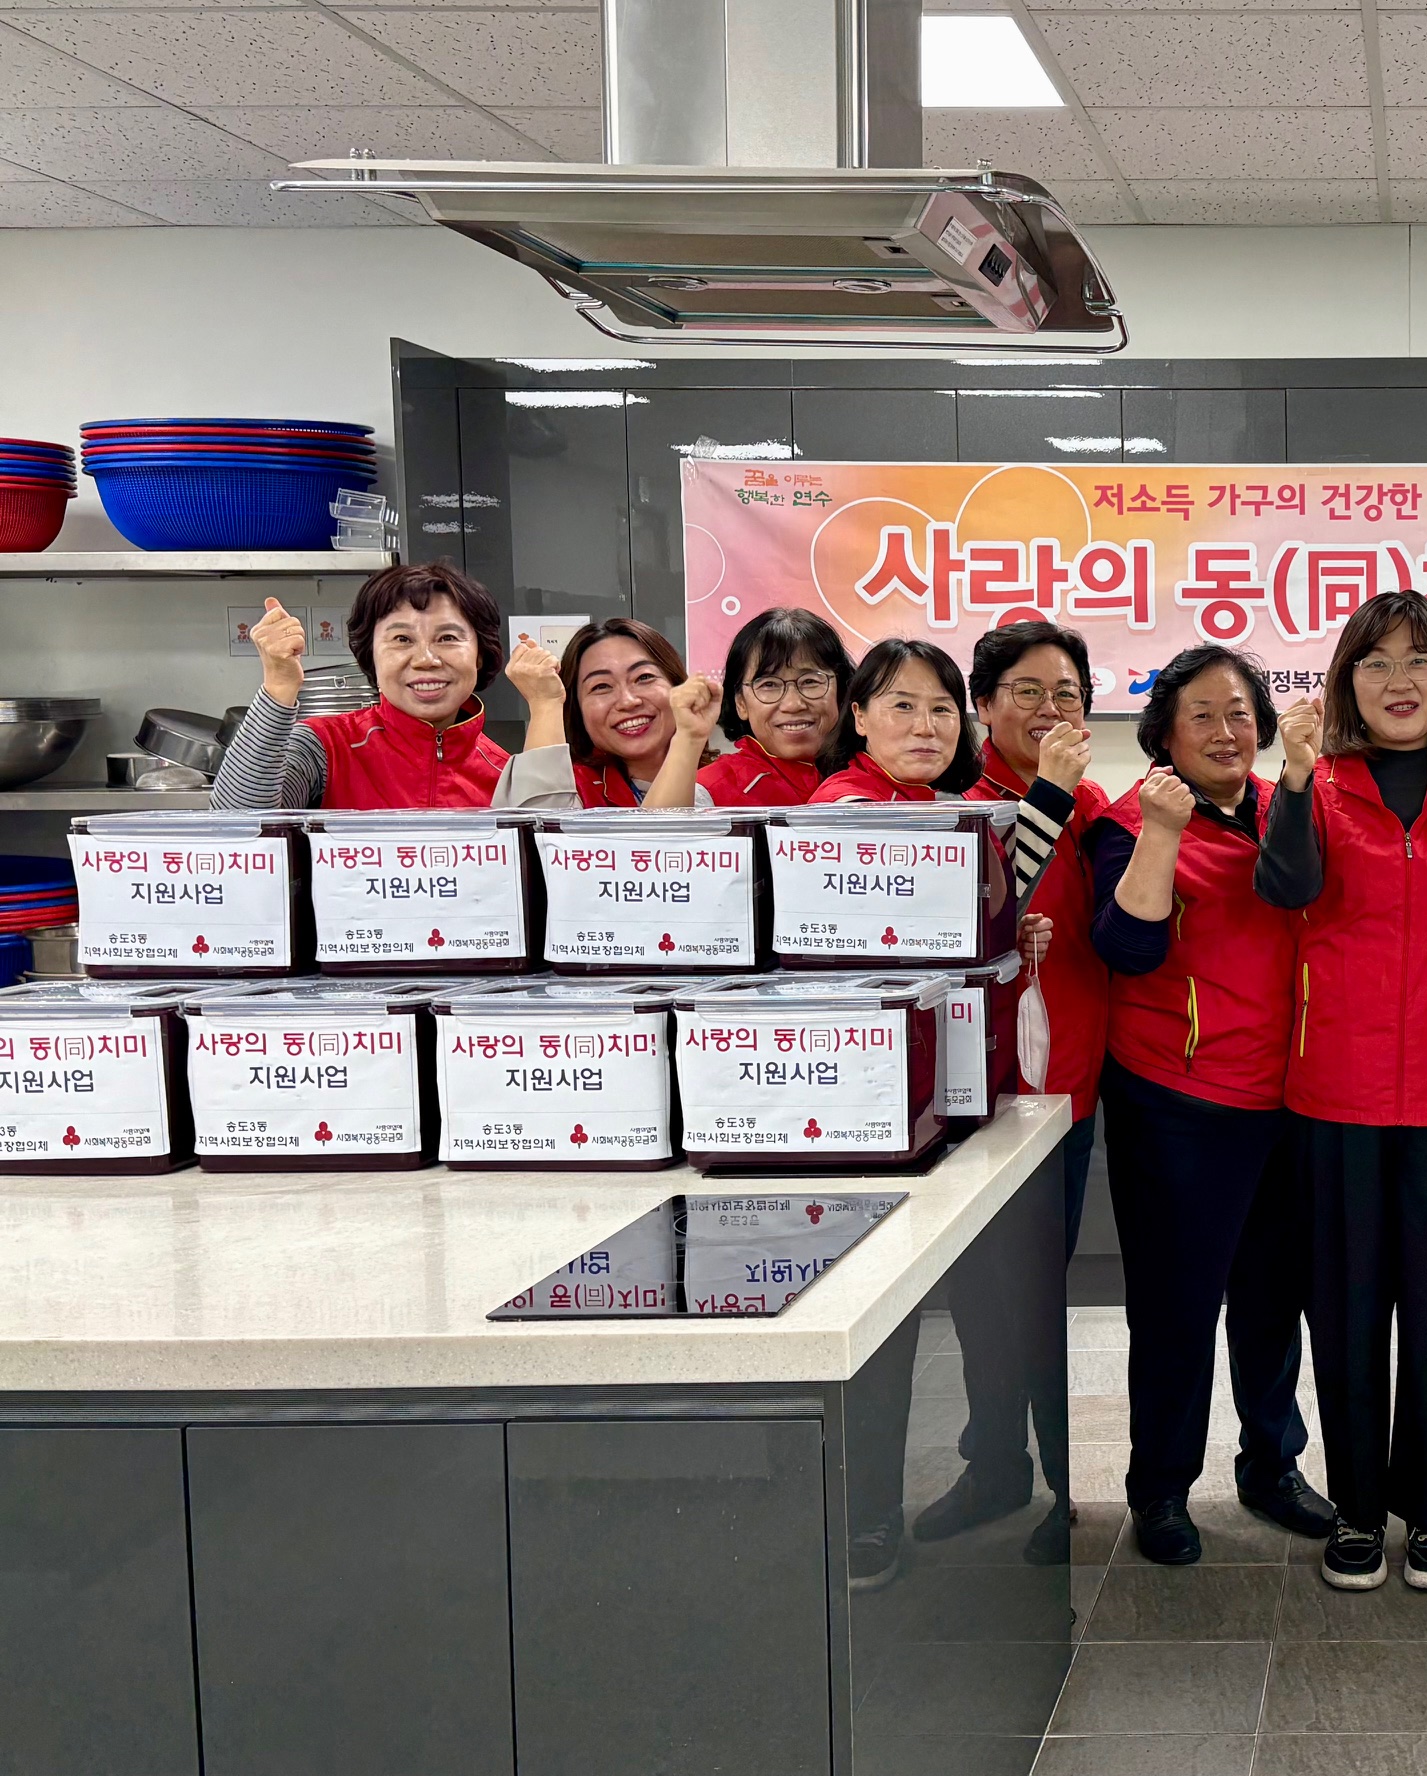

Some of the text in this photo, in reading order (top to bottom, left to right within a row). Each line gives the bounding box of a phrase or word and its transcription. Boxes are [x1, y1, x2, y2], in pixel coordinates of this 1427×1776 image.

[744, 469, 823, 487] 꿈을 이루는
[734, 488, 832, 507] 행복한 연수
[1093, 483, 1195, 521] 저소득
[1207, 483, 1306, 516] 가구의
[1321, 482, 1422, 522] 건강한
[862, 529, 1149, 629] 사랑의
[316, 844, 506, 869] 사랑의 동(同)치미
[551, 849, 739, 873] 사랑의 동(同)치미
[776, 841, 965, 867] 사랑의 동(同)치미
[82, 851, 274, 875] 사랑의 동(同)치미
[366, 877, 457, 899] 지원사업
[599, 881, 690, 902] 지원사업
[823, 873, 914, 896] 지원사업
[131, 883, 223, 904] 지원사업
[345, 929, 383, 940] 송도3동
[800, 923, 837, 934] 송도3동
[109, 934, 147, 944] 송도3동
[448, 938, 509, 949] 사회복지공동모금회
[577, 932, 614, 942] 송도3동
[776, 935, 867, 949] 지역사회보장협의체
[320, 943, 413, 953] 지역사회보장협의체
[552, 944, 644, 956] 지역사회보장협의체
[678, 945, 739, 955] 사회복지공동모금회
[901, 939, 961, 950] 사회복지공동모금회
[85, 947, 177, 958] 지역사회보장협의체
[213, 947, 274, 957] 사회복지공동모금회
[196, 1032, 401, 1056] 사랑의 동(同)치미
[452, 1035, 523, 1058] 사랑의
[686, 1028, 892, 1052] 사랑의 동(同)치미
[30, 1035, 146, 1060] 동(同)치미
[250, 1066, 347, 1089] 지원사업
[506, 1068, 602, 1091] 지원사업
[739, 1062, 837, 1085] 지원사업
[0, 1070, 93, 1093] 지원사업
[227, 1122, 267, 1132] 송도3동
[483, 1124, 523, 1135] 송도3동
[715, 1118, 756, 1128] 송도3동
[84, 1133, 151, 1146] 사회복지공동모금회
[337, 1133, 403, 1145] 사회복지공동모금회
[592, 1135, 657, 1146] 사회복지공동모금회
[687, 1132, 788, 1144] 지역사회보장협의체
[825, 1126, 891, 1141] 사회복지공동모금회
[199, 1136, 299, 1147] 지역사회보장협의체
[454, 1139, 555, 1150] 지역사회보장협의체
